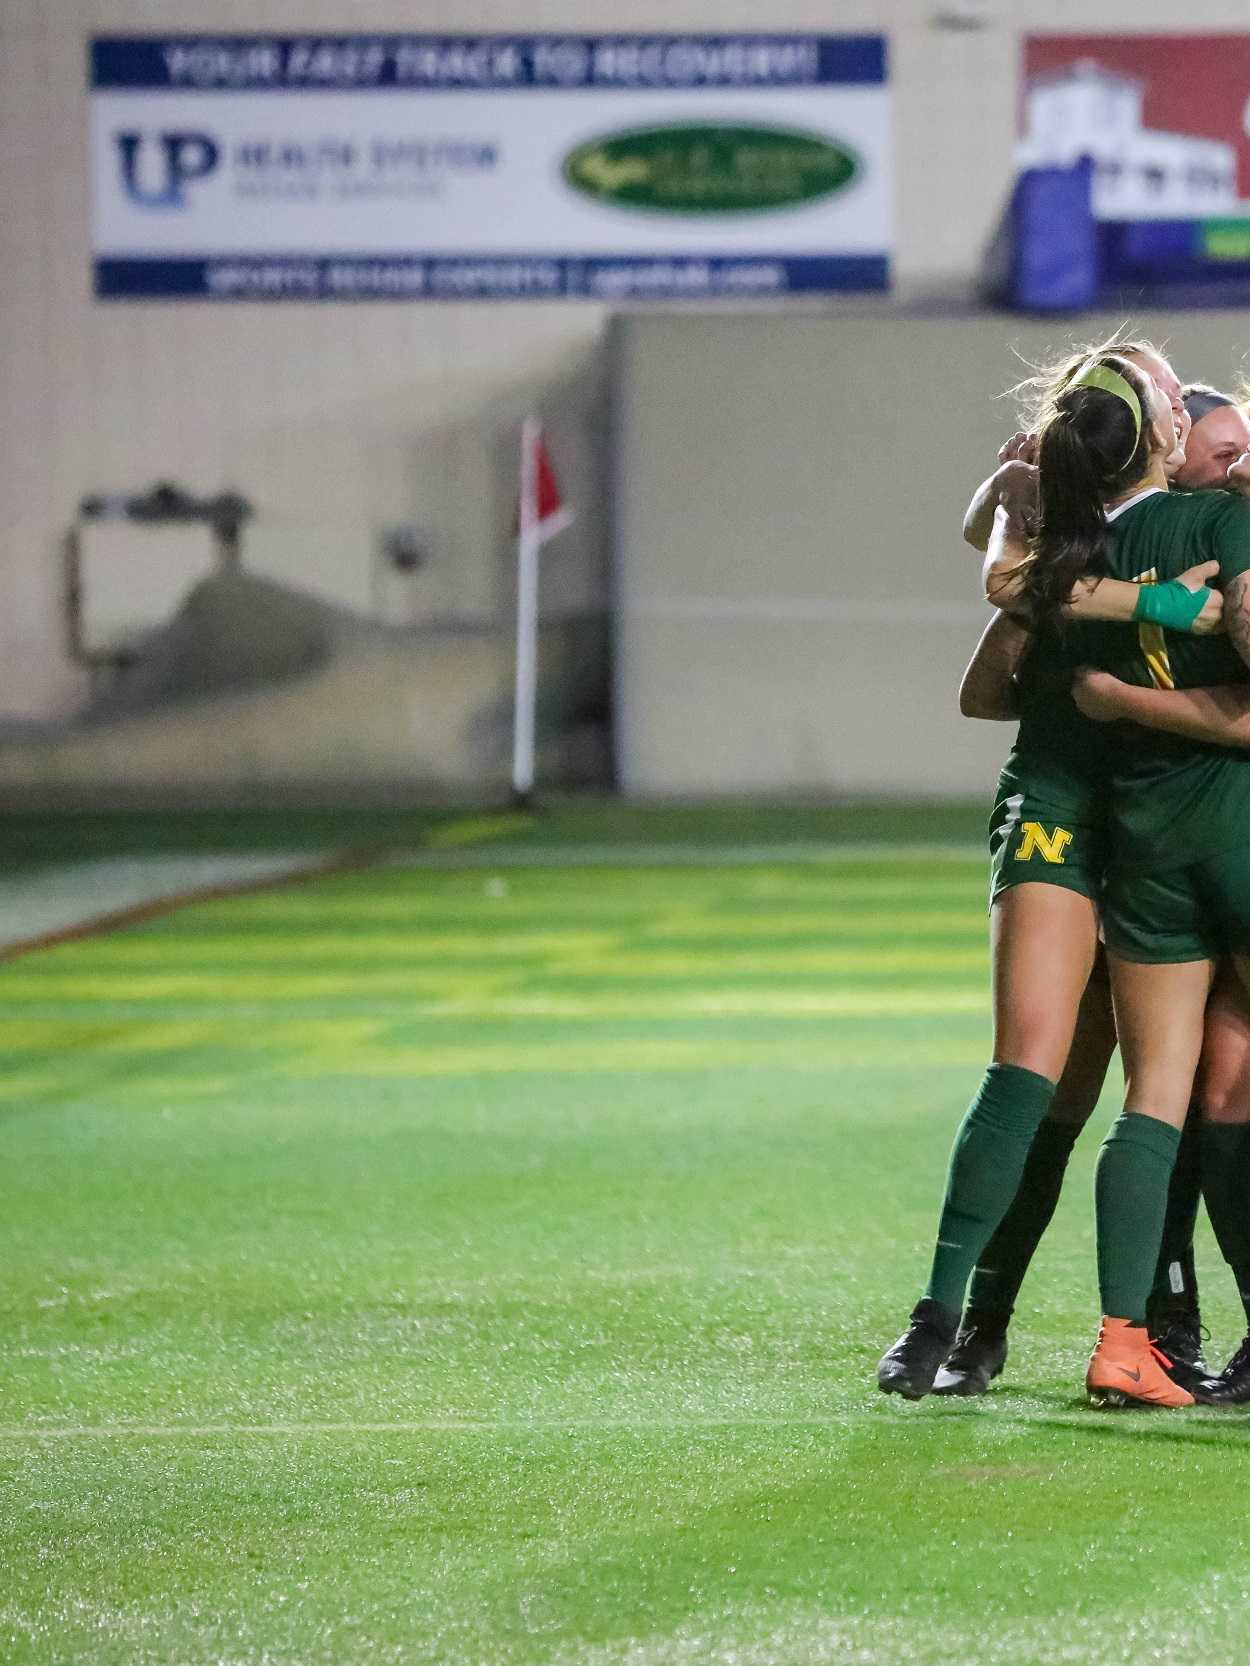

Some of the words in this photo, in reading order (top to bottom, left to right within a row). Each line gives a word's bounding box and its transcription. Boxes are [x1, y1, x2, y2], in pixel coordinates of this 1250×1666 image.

[165, 46, 281, 82] YOUR
[283, 46, 386, 82] FAST
[395, 46, 523, 82] TRACK
[533, 46, 588, 82] TO
[116, 132, 220, 208] UP
[1014, 821, 1073, 864] N
